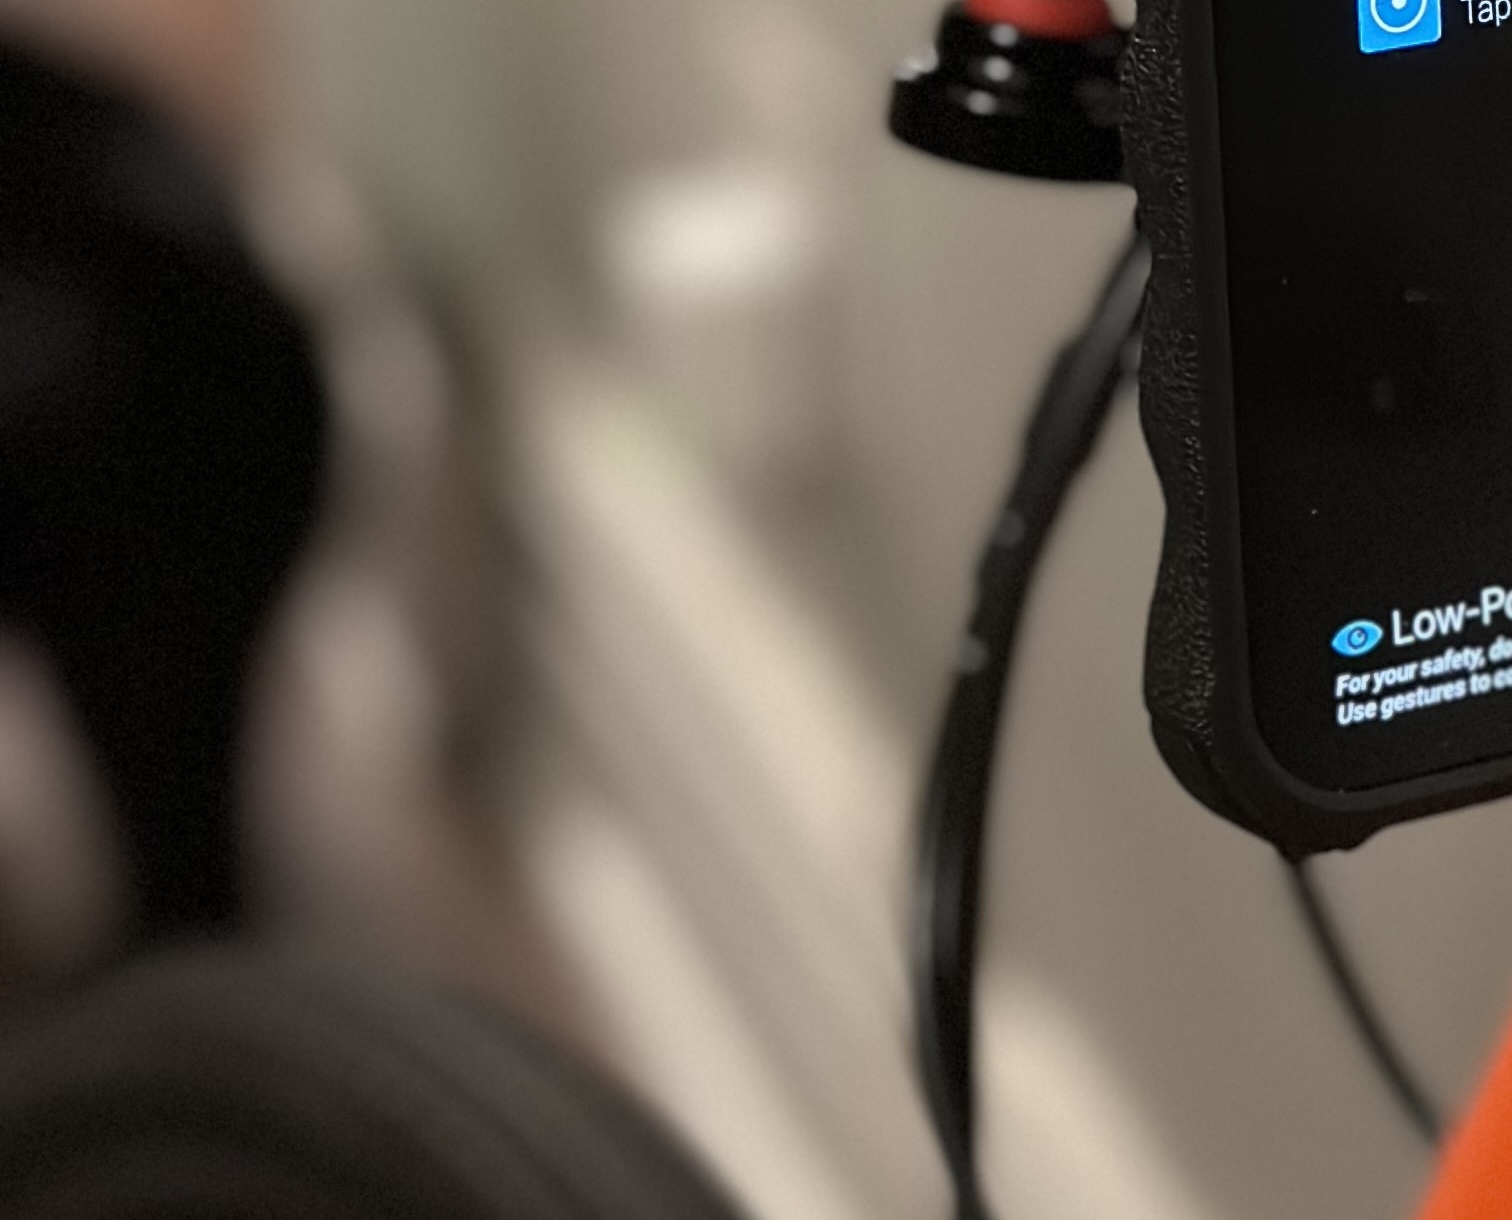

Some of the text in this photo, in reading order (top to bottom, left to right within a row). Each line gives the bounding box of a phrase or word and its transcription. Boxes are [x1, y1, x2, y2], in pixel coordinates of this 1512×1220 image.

[1336, 673, 1371, 698] For
[1372, 662, 1418, 694] your
[1419, 646, 1486, 678] safety,
[1336, 700, 1378, 726] Use
[1379, 678, 1467, 721] gestures
[1468, 673, 1492, 695] to
